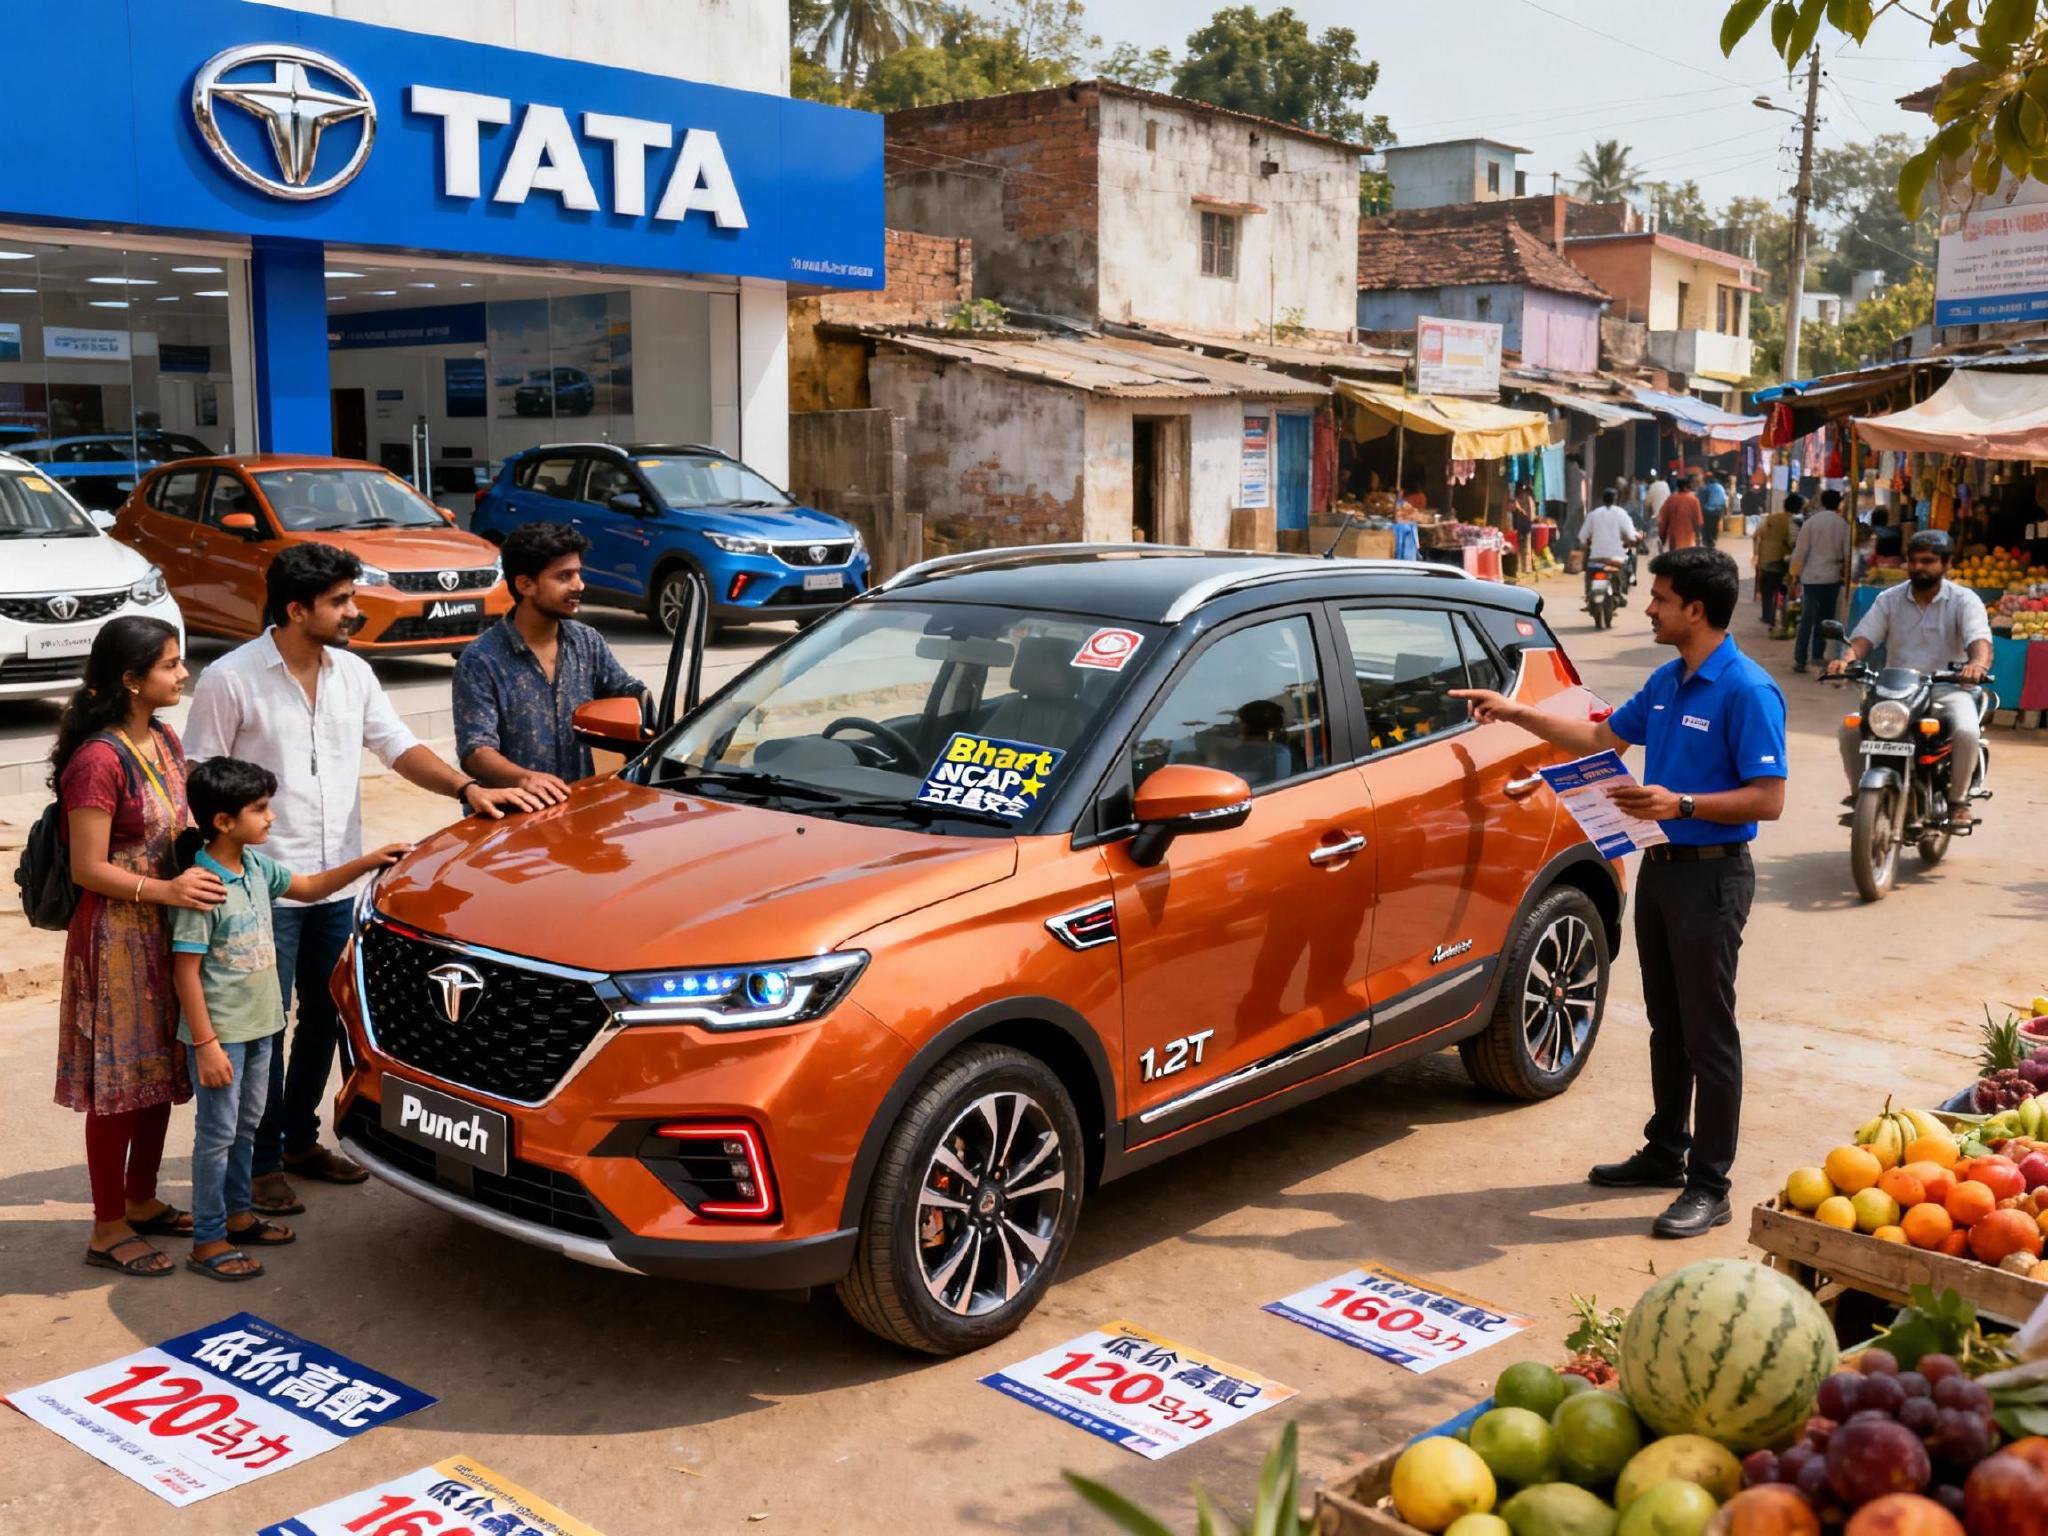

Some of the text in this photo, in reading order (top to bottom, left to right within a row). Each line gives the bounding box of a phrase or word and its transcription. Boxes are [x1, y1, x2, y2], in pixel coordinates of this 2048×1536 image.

[410, 84, 748, 230] TATA
[935, 762, 1021, 792] NCAP
[1139, 1028, 1214, 1083] 1.2T
[400, 1094, 489, 1155] Punch
